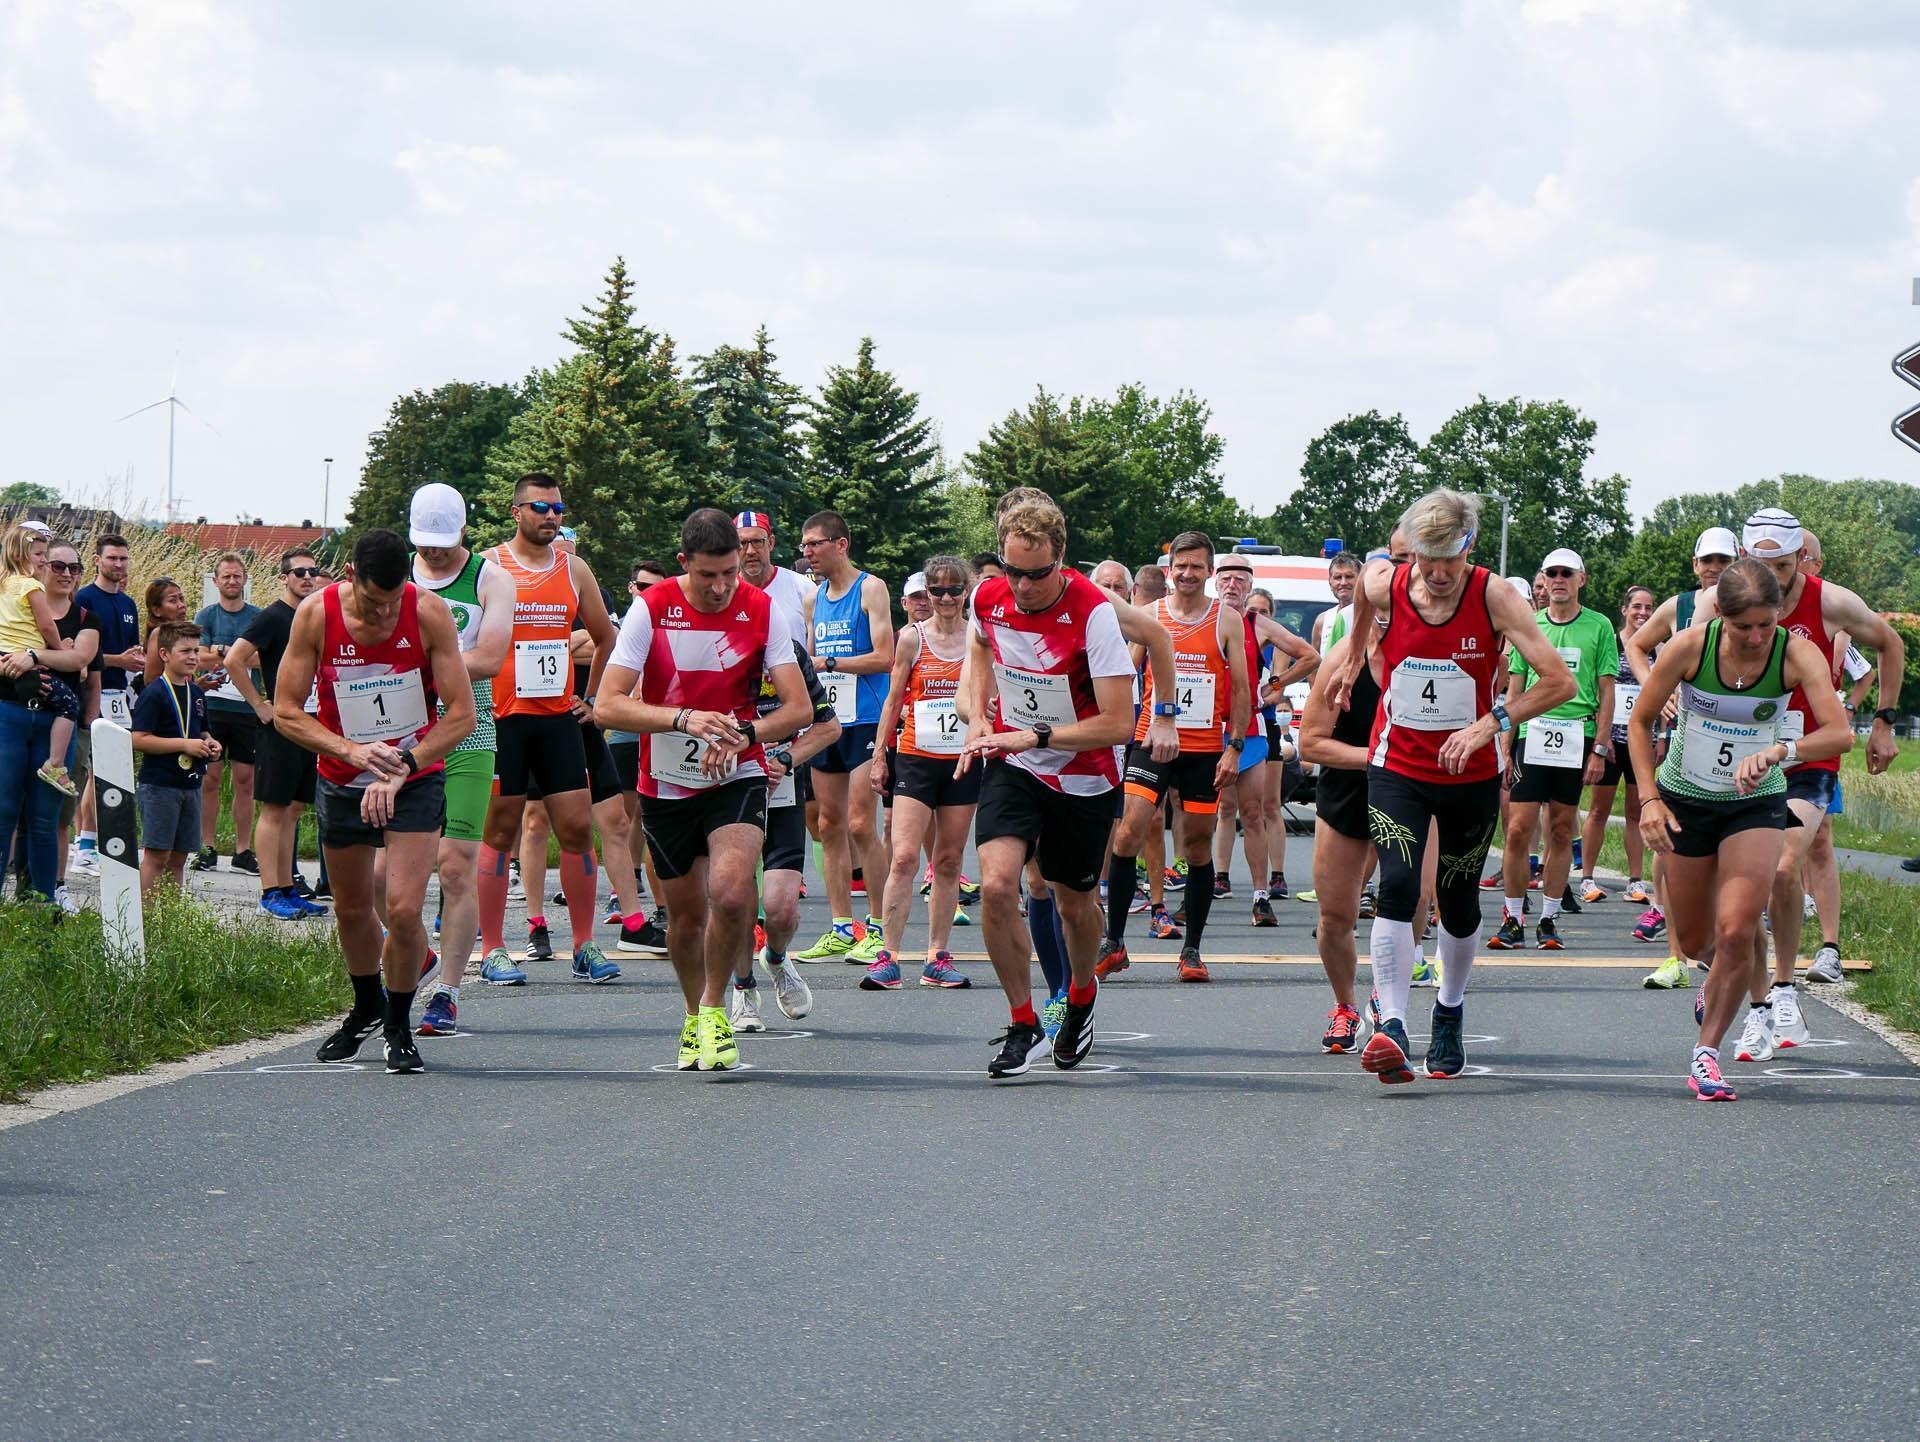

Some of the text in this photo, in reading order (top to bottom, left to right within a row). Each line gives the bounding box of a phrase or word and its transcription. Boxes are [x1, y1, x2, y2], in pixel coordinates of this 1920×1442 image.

[515, 602, 568, 613] Hofmann
[667, 606, 683, 618] LG
[991, 604, 1005, 618] LG
[660, 618, 691, 628] Elangen
[340, 644, 356, 656] LG
[527, 643, 562, 651] Helmholz
[836, 645, 853, 653] Roth
[1461, 637, 1476, 650] LG
[332, 657, 365, 666] Erlangen
[1175, 651, 1206, 661] fmann
[1452, 652, 1485, 660] Erlangen
[537, 655, 557, 676] 13
[1402, 660, 1457, 672] Helmholz
[927, 679, 960, 688] Hofma
[1005, 669, 1053, 686] Helmholz
[349, 678, 404, 692] Helmholz
[1421, 679, 1437, 704] 4
[111, 699, 124, 714] 61
[373, 694, 386, 716] 1
[1023, 689, 1038, 711] 3
[1625, 696, 1634, 710] 5
[1420, 705, 1440, 714] John
[375, 718, 392, 727] Axel
[937, 713, 959, 733] 12
[1702, 720, 1760, 736] Helmholz
[1543, 730, 1564, 749] 29
[684, 739, 699, 763] 2
[1717, 742, 1735, 767] 5
[1711, 767, 1734, 778] Elvira
